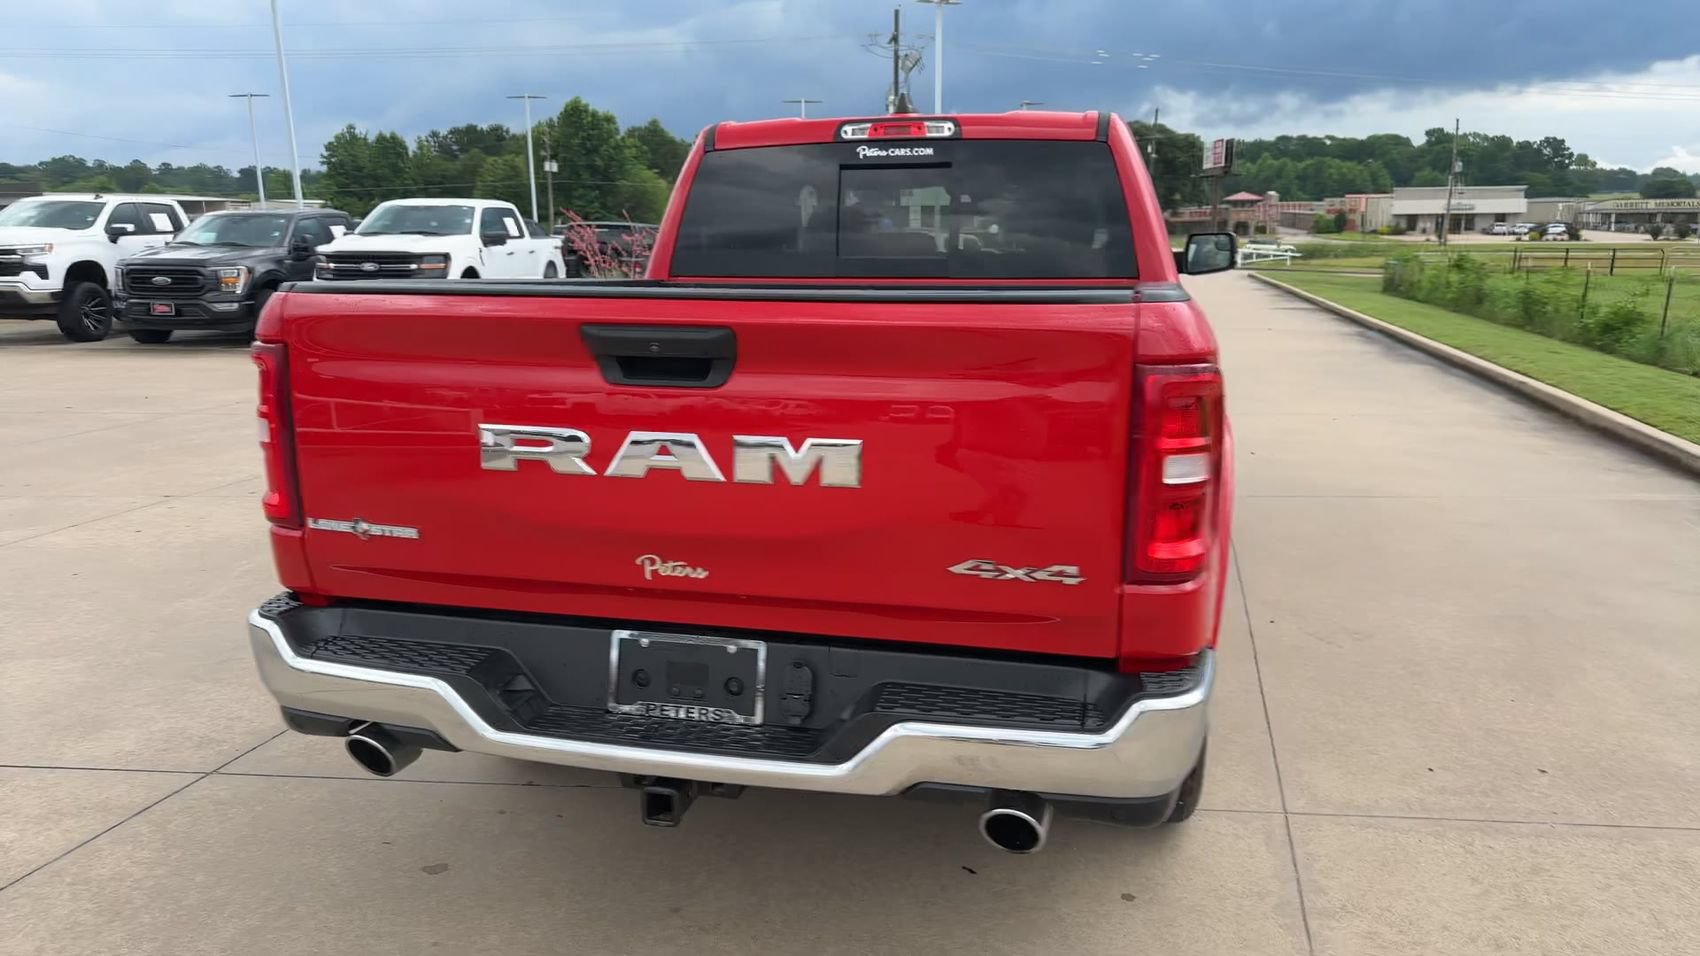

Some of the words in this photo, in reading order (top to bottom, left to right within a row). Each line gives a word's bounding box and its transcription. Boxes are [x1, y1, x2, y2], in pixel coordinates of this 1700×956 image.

[478, 423, 863, 489] RAM
[635, 554, 709, 580] Peters
[946, 559, 1088, 585] 4x4
[644, 702, 725, 722] PETERS
